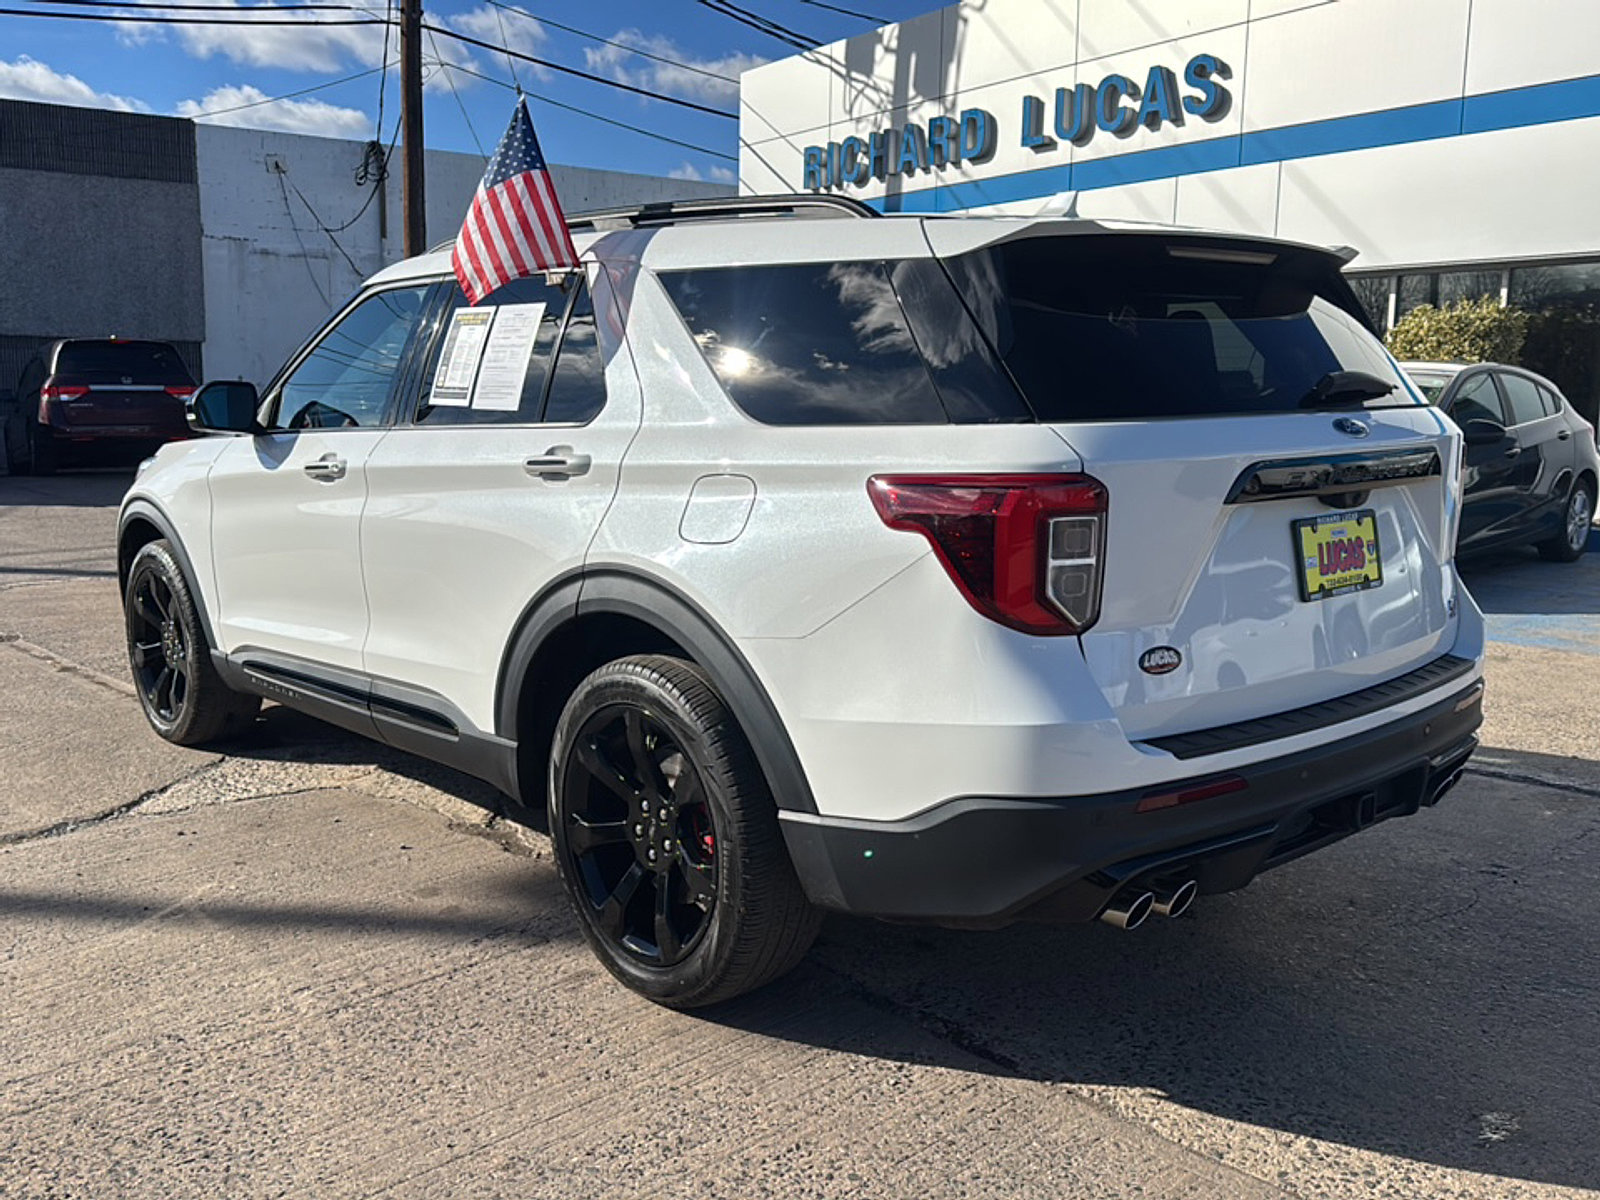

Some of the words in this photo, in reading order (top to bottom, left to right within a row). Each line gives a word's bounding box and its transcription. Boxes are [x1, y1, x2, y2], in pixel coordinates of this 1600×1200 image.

[803, 108, 997, 194] RICHARD
[1021, 54, 1233, 153] LUCAS
[1317, 536, 1366, 576] LUCAS
[1143, 649, 1179, 667] LUCAS
